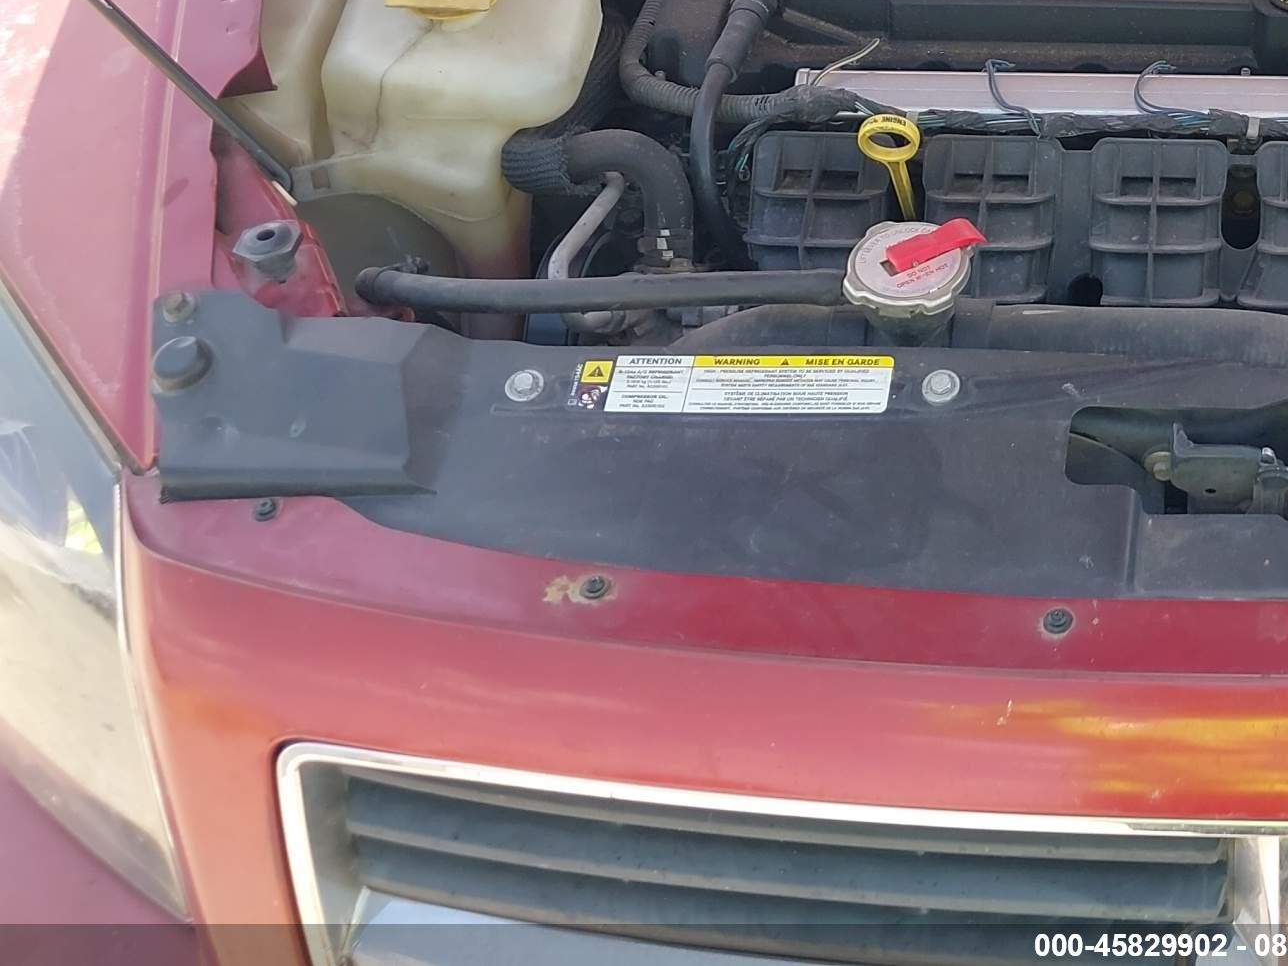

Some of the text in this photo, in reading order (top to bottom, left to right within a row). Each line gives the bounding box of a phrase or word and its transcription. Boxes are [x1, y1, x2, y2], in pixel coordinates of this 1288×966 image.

[881, 116, 907, 127] ENGINE
[896, 278, 915, 289] OPEN
[935, 263, 949, 273] HOT
